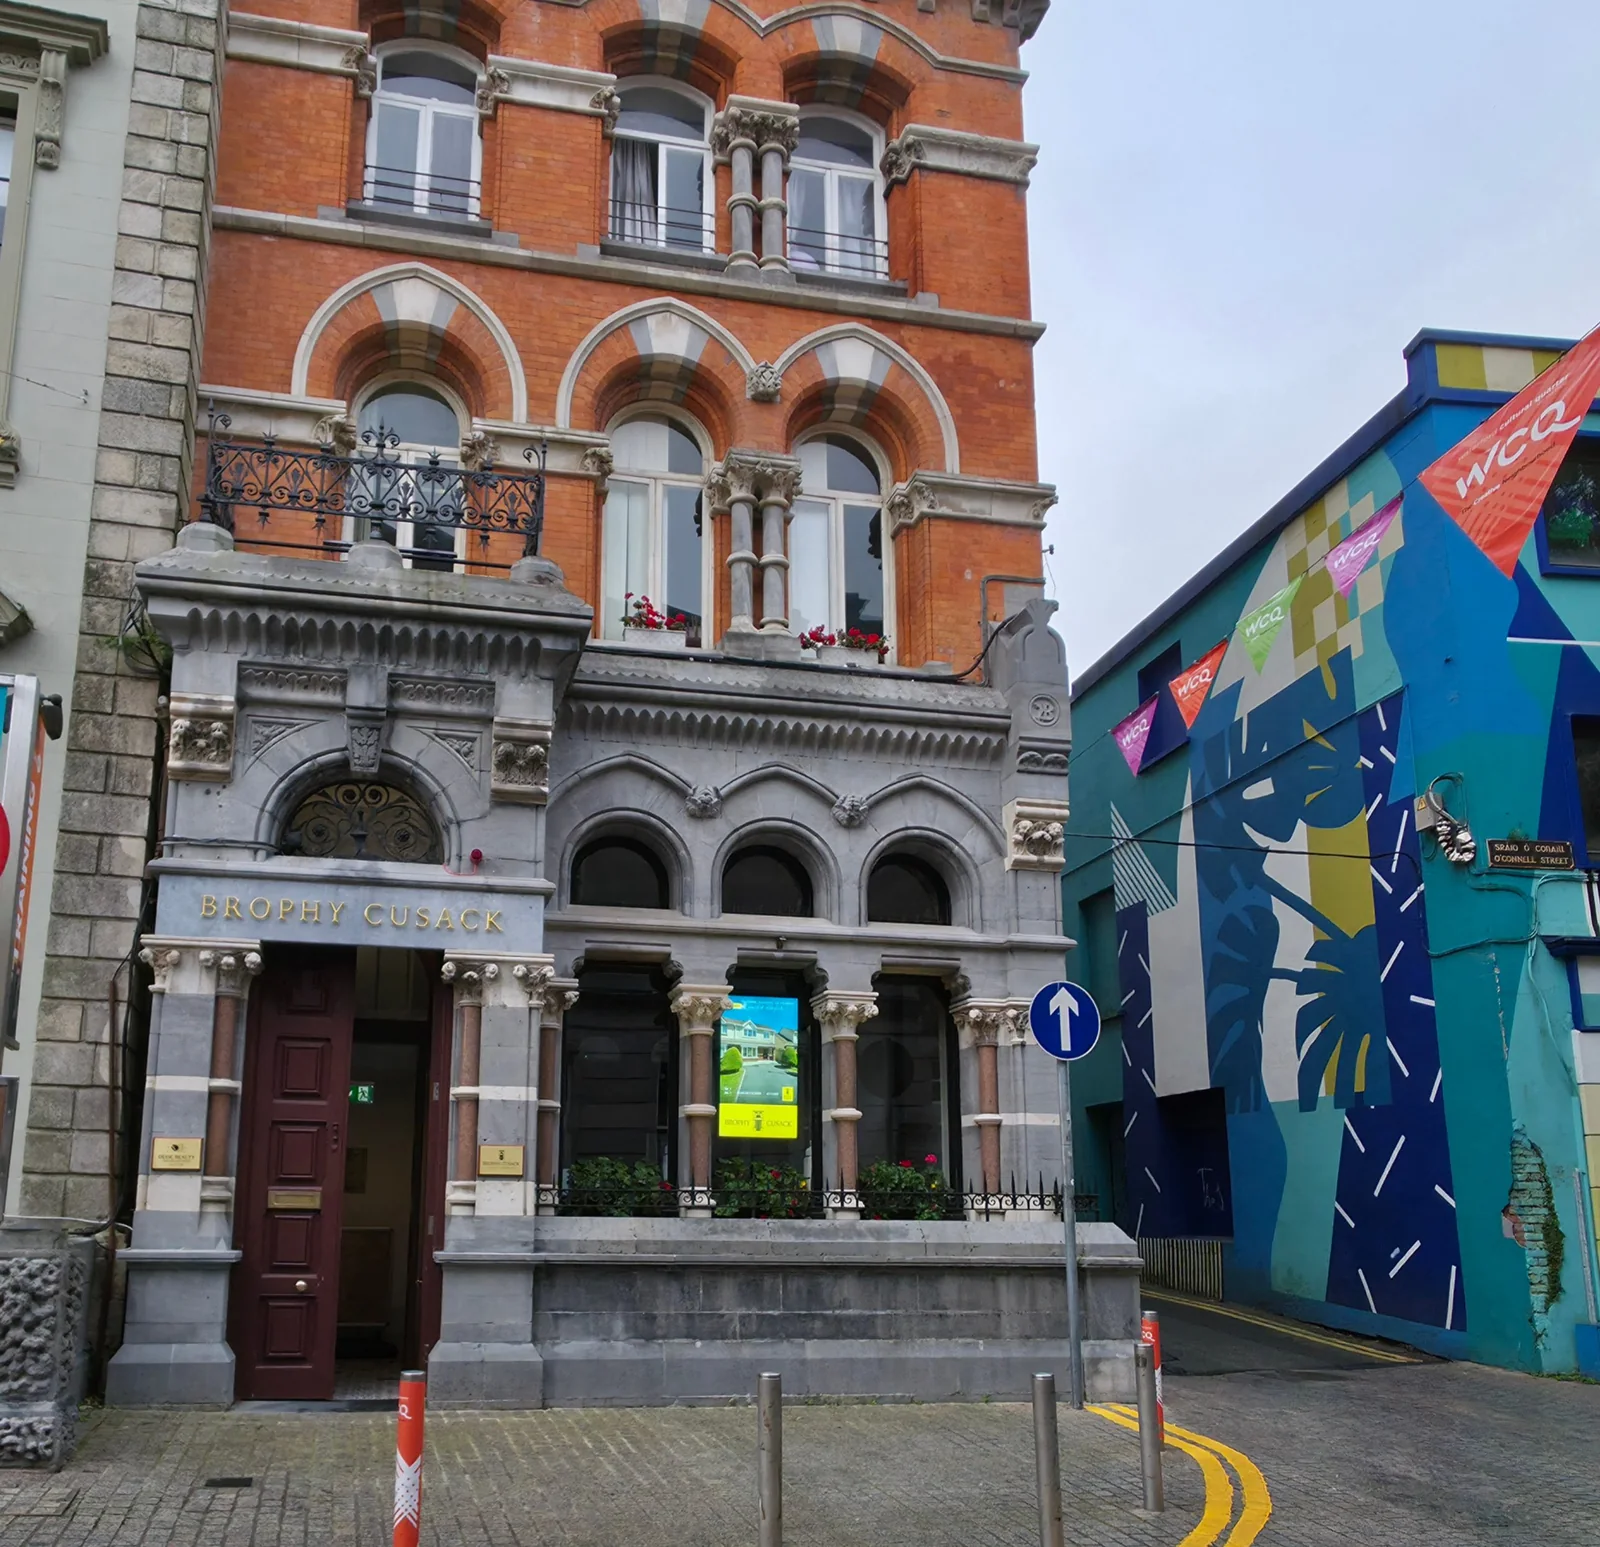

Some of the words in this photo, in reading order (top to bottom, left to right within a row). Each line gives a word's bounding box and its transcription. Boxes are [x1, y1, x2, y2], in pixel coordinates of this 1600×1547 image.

[1456, 399, 1581, 499] WCQ
[1333, 532, 1381, 569] WCQ
[1245, 606, 1285, 637] WCQ
[1178, 668, 1214, 697] WCQ
[1122, 718, 1151, 747] WCQ
[1494, 854, 1537, 864] O'CONNELL
[1540, 856, 1569, 865] STREET
[200, 894, 346, 926] BROPHY
[363, 902, 504, 933] CUSACK
